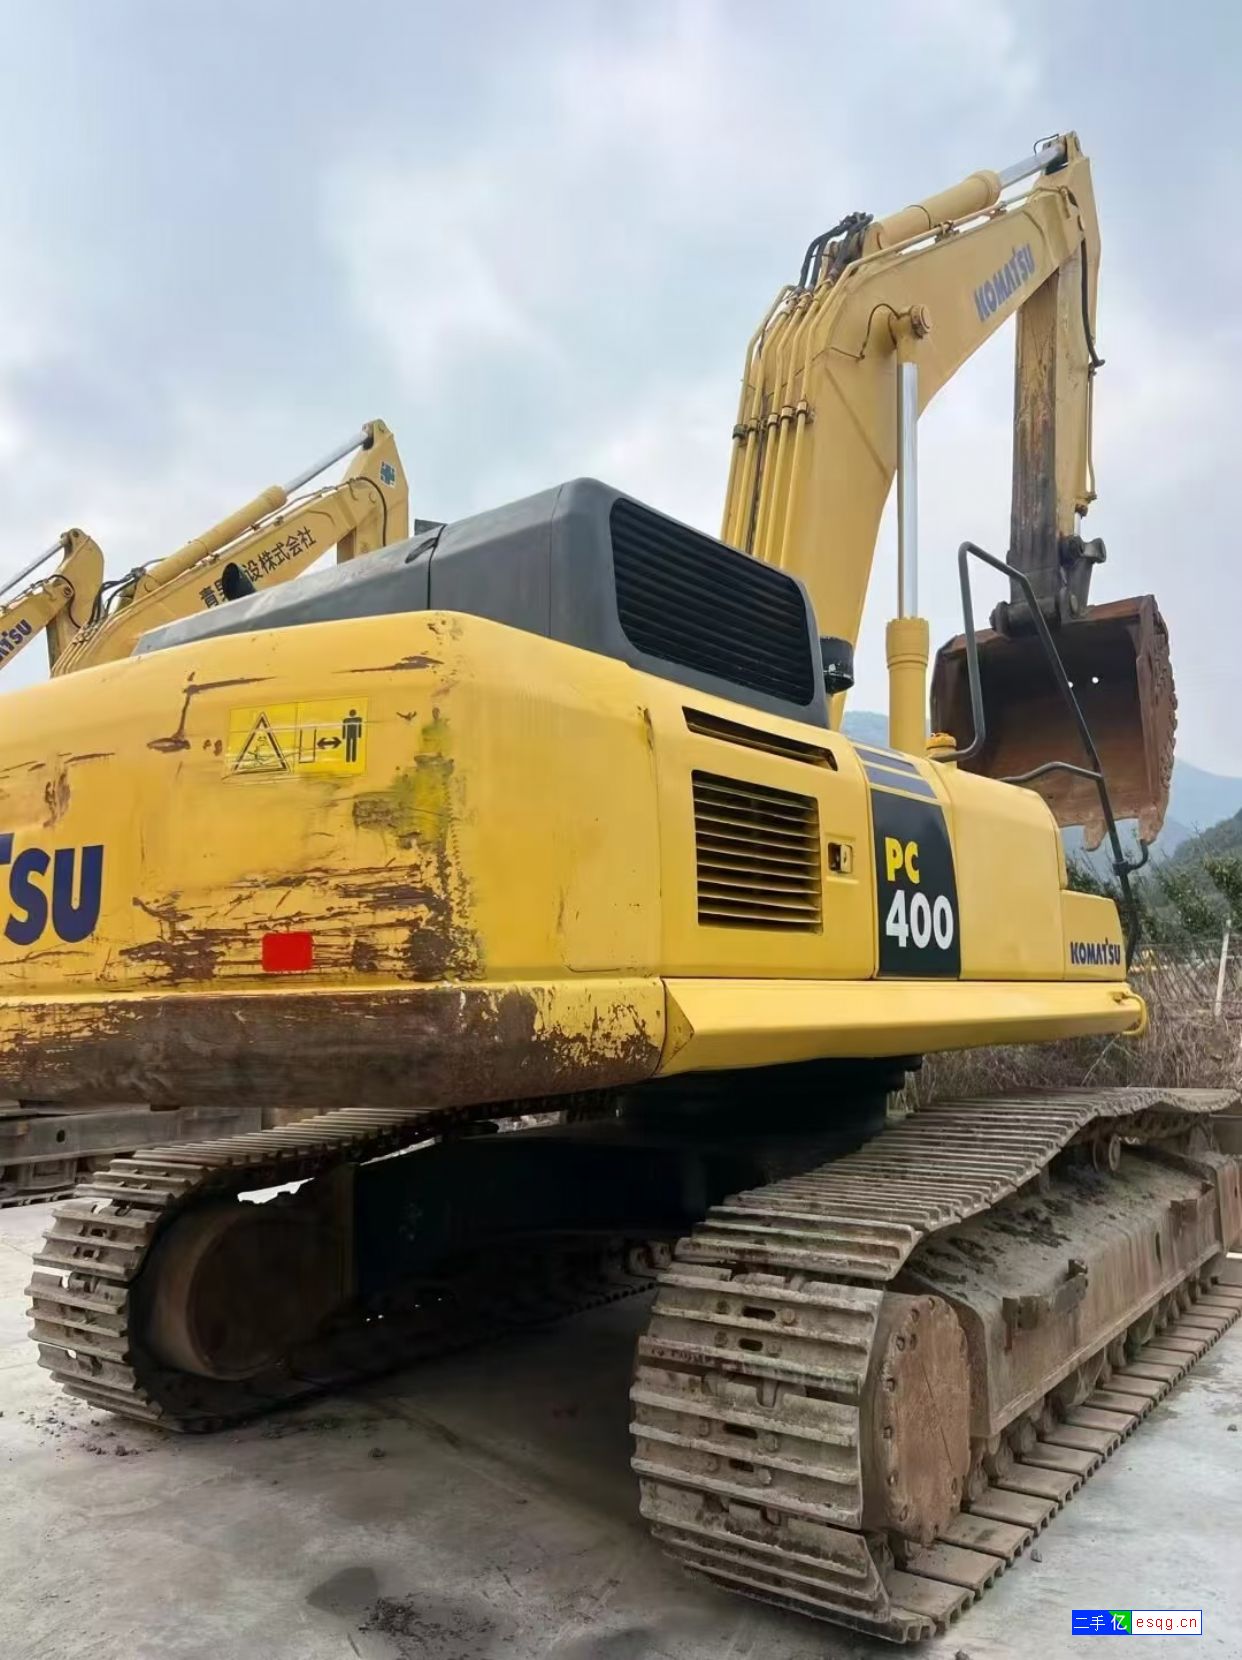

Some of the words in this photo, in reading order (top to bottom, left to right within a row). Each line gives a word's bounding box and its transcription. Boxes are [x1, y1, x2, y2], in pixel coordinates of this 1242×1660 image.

[974, 243, 1035, 322] KOMATSU
[885, 836, 920, 884] PC
[886, 889, 954, 950] 400
[1070, 936, 1121, 966] KOMATSU
